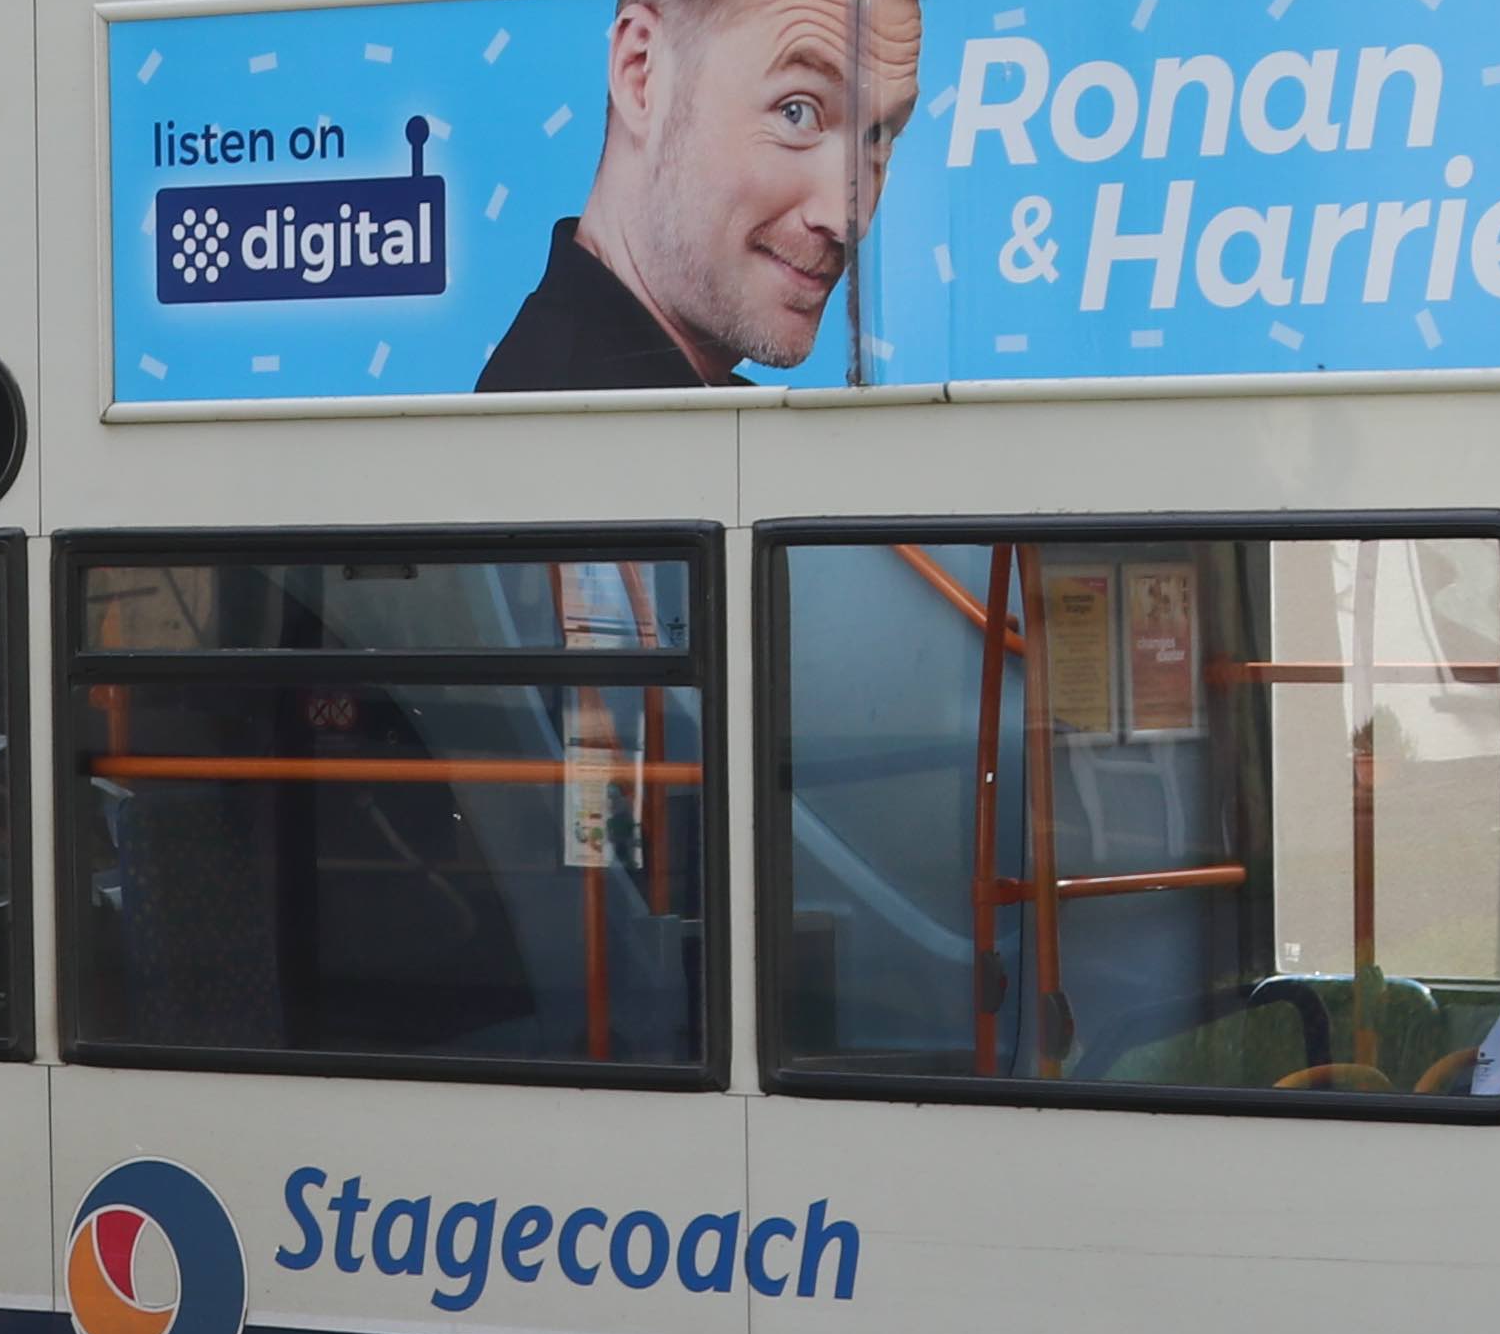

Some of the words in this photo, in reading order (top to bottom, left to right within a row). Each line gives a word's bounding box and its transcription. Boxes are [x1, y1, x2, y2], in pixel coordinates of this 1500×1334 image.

[153, 121, 276, 167] listen
[289, 124, 345, 160] on
[946, 35, 1445, 169] Ronan
[241, 202, 432, 284] digital
[998, 195, 1061, 284] &
[274, 1166, 861, 1312] Stagecoach
